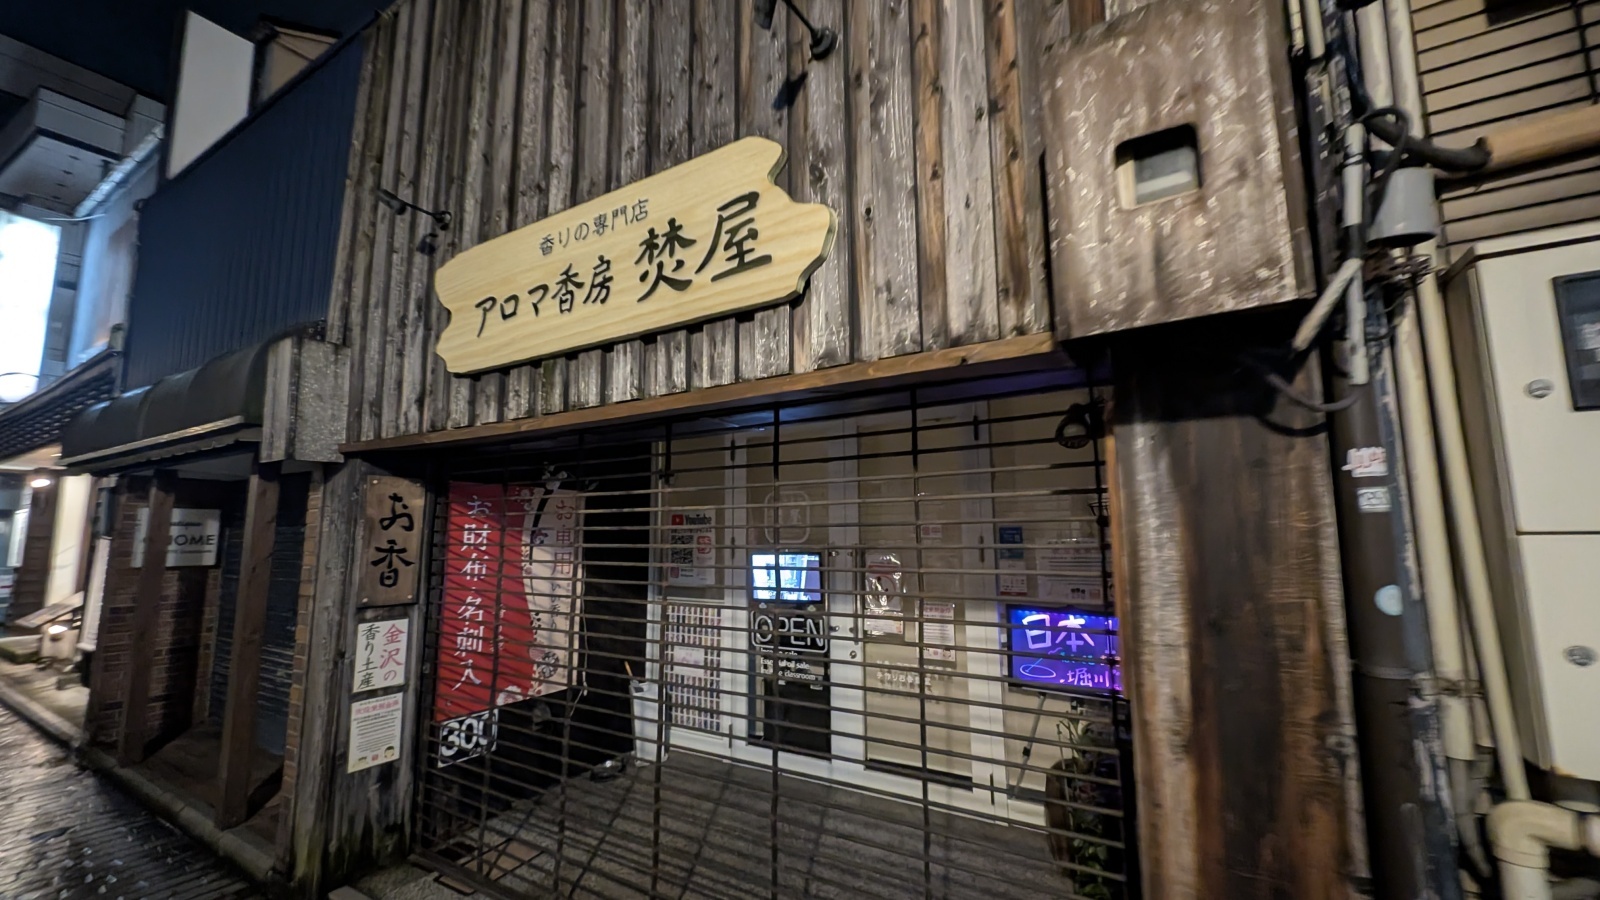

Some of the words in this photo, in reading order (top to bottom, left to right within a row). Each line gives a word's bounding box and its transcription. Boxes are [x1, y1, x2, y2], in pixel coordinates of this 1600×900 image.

[538, 199, 650, 256] 香りの専門店
[474, 254, 614, 338] アロマ香房
[634, 191, 773, 304] 焚屋
[370, 492, 415, 588] お香
[357, 623, 381, 690] 香り土産
[379, 623, 406, 682] 金沢の
[755, 615, 824, 647] OPEN
